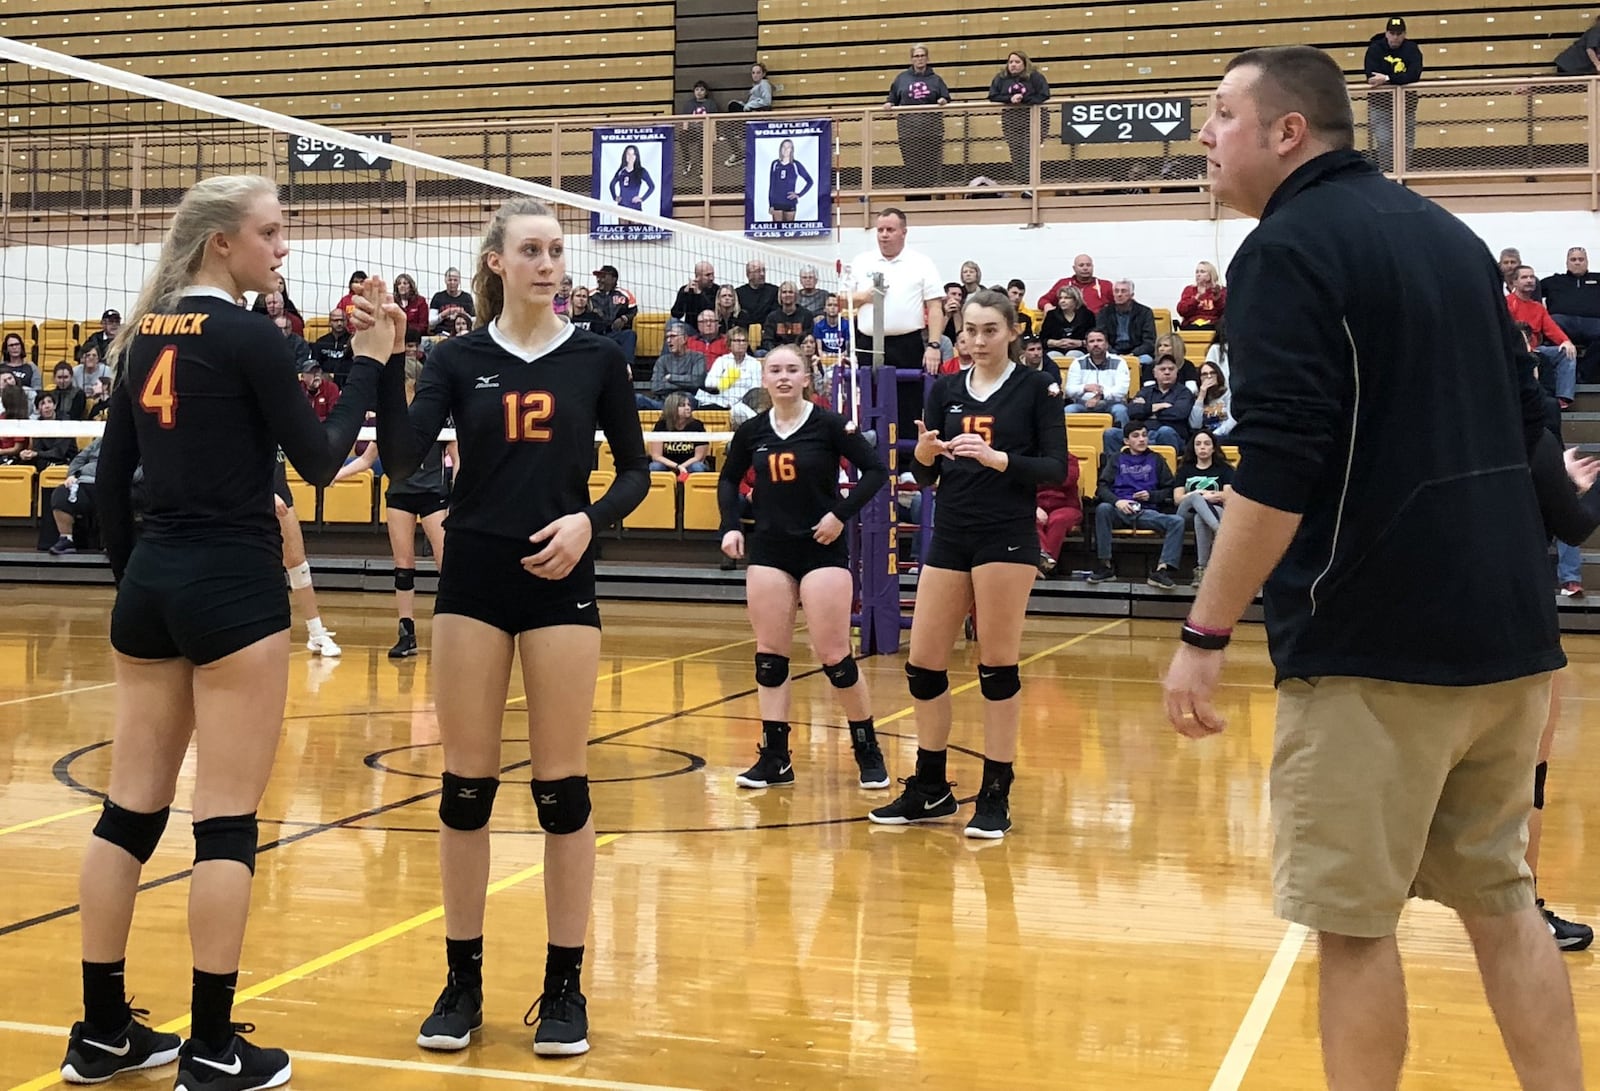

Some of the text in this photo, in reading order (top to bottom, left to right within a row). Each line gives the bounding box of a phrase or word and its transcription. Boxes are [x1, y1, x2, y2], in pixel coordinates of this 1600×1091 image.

[1072, 102, 1181, 122] SECTION
[755, 128, 823, 136] VOLLEYBALL
[1118, 122, 1133, 139] 2
[333, 153, 345, 168] 2
[140, 344, 178, 430] 4
[502, 390, 556, 441] 12
[961, 414, 995, 447] 15
[767, 451, 797, 483] 16
[887, 423, 898, 575] BUTLER
